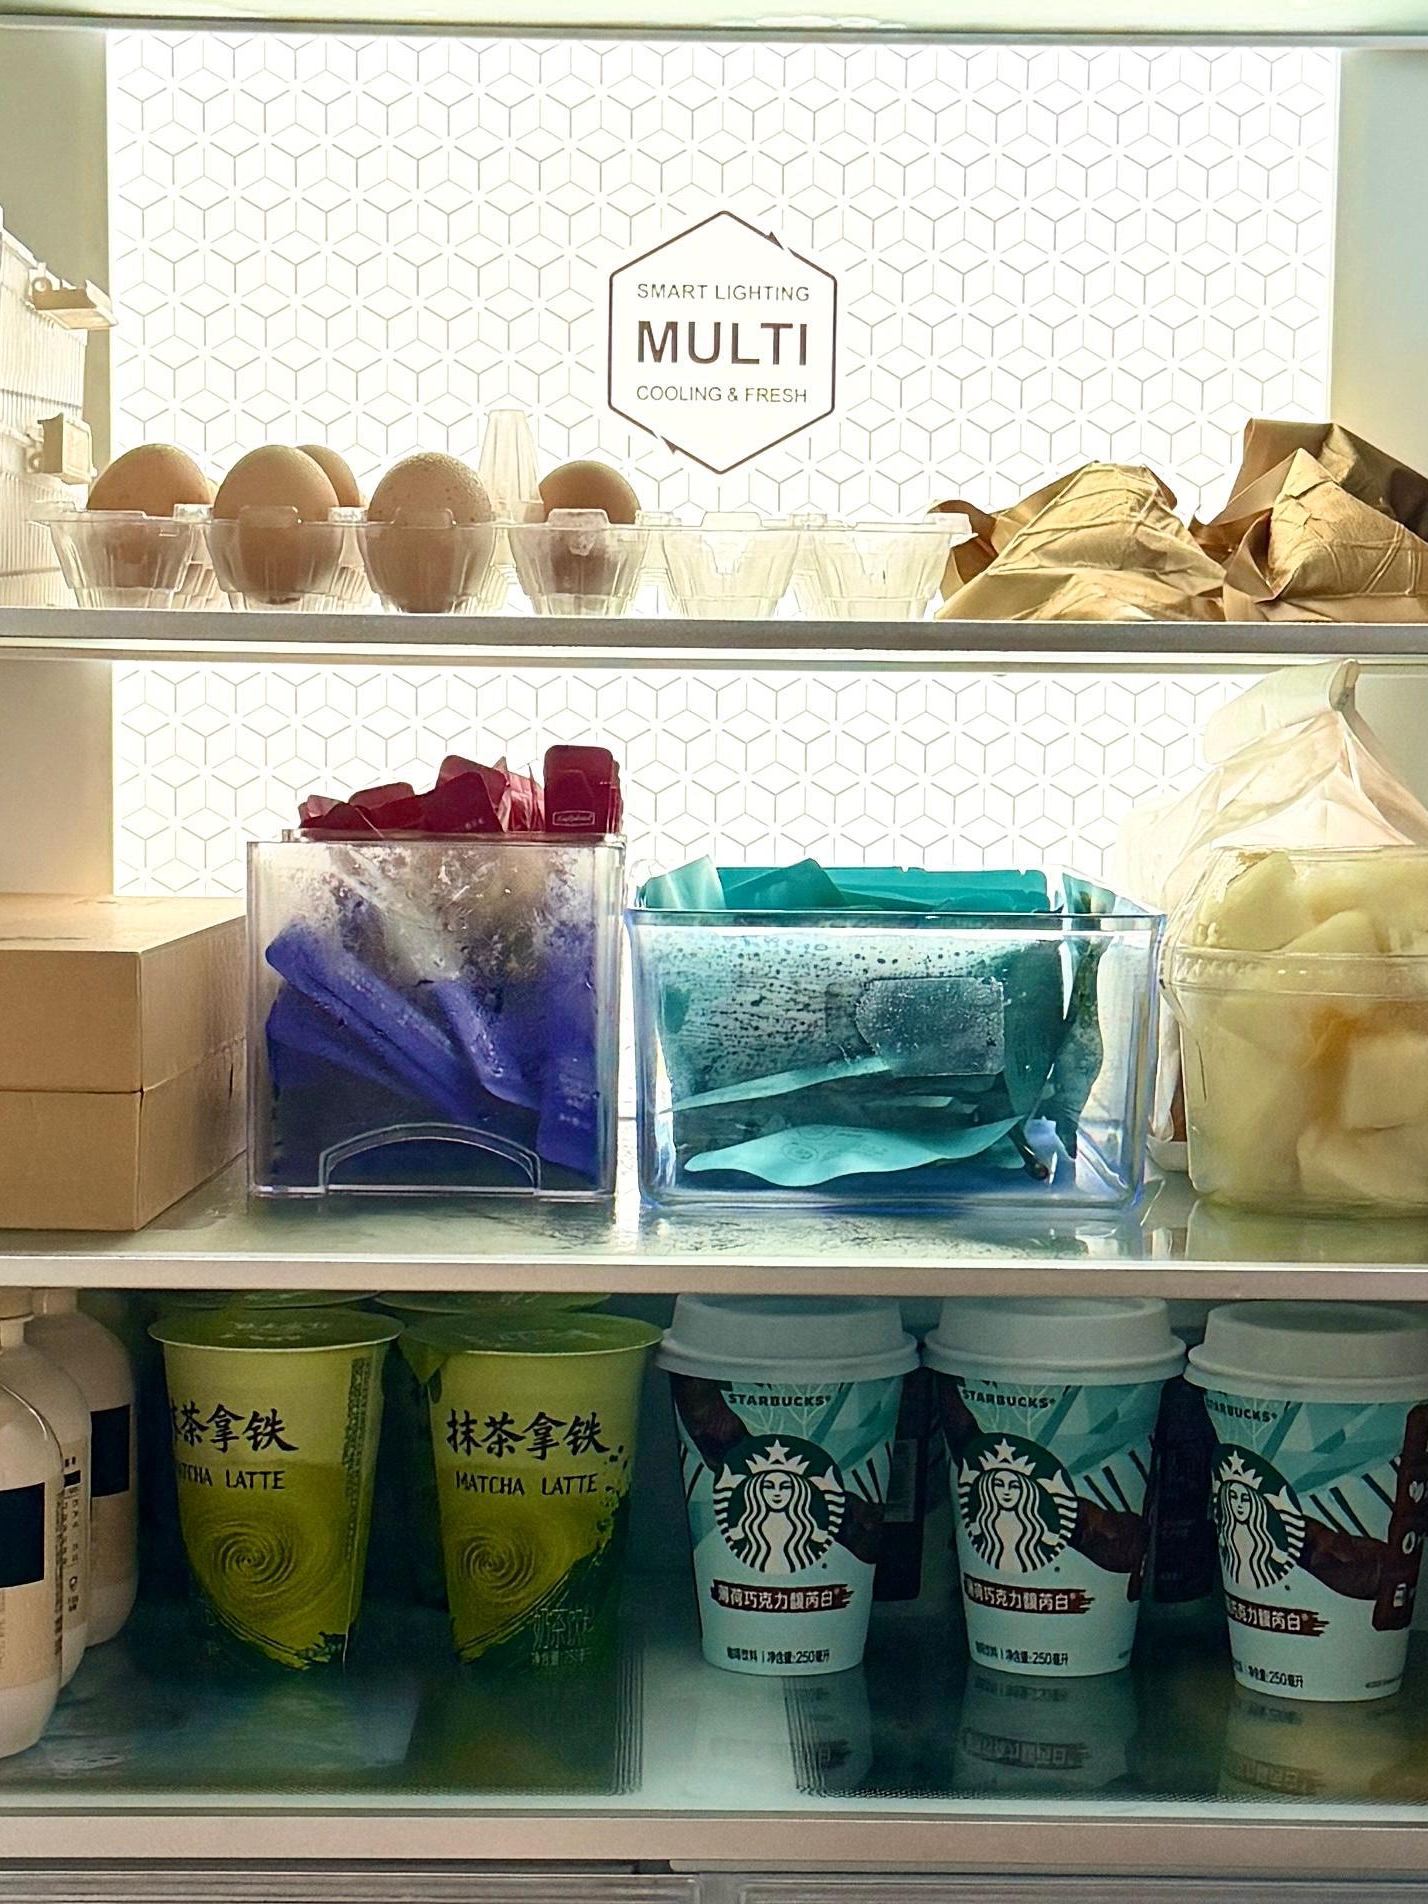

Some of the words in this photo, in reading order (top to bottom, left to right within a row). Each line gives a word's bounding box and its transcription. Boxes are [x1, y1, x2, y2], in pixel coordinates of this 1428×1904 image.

[637, 283, 708, 300] SMART
[715, 284, 810, 302] LIGHTING
[637, 320, 808, 366] MULTI
[636, 385, 722, 402] COOLING
[727, 387, 738, 402] &
[745, 387, 808, 403] FRESH
[728, 1394, 825, 1407] STARBUCKS
[963, 1389, 1051, 1411] STARBUCKS
[446, 1408, 611, 1461] 抹茶拿铁
[225, 1469, 286, 1490] LATTE
[456, 1470, 525, 1496] MATCHA
[541, 1471, 599, 1496] LATTE
